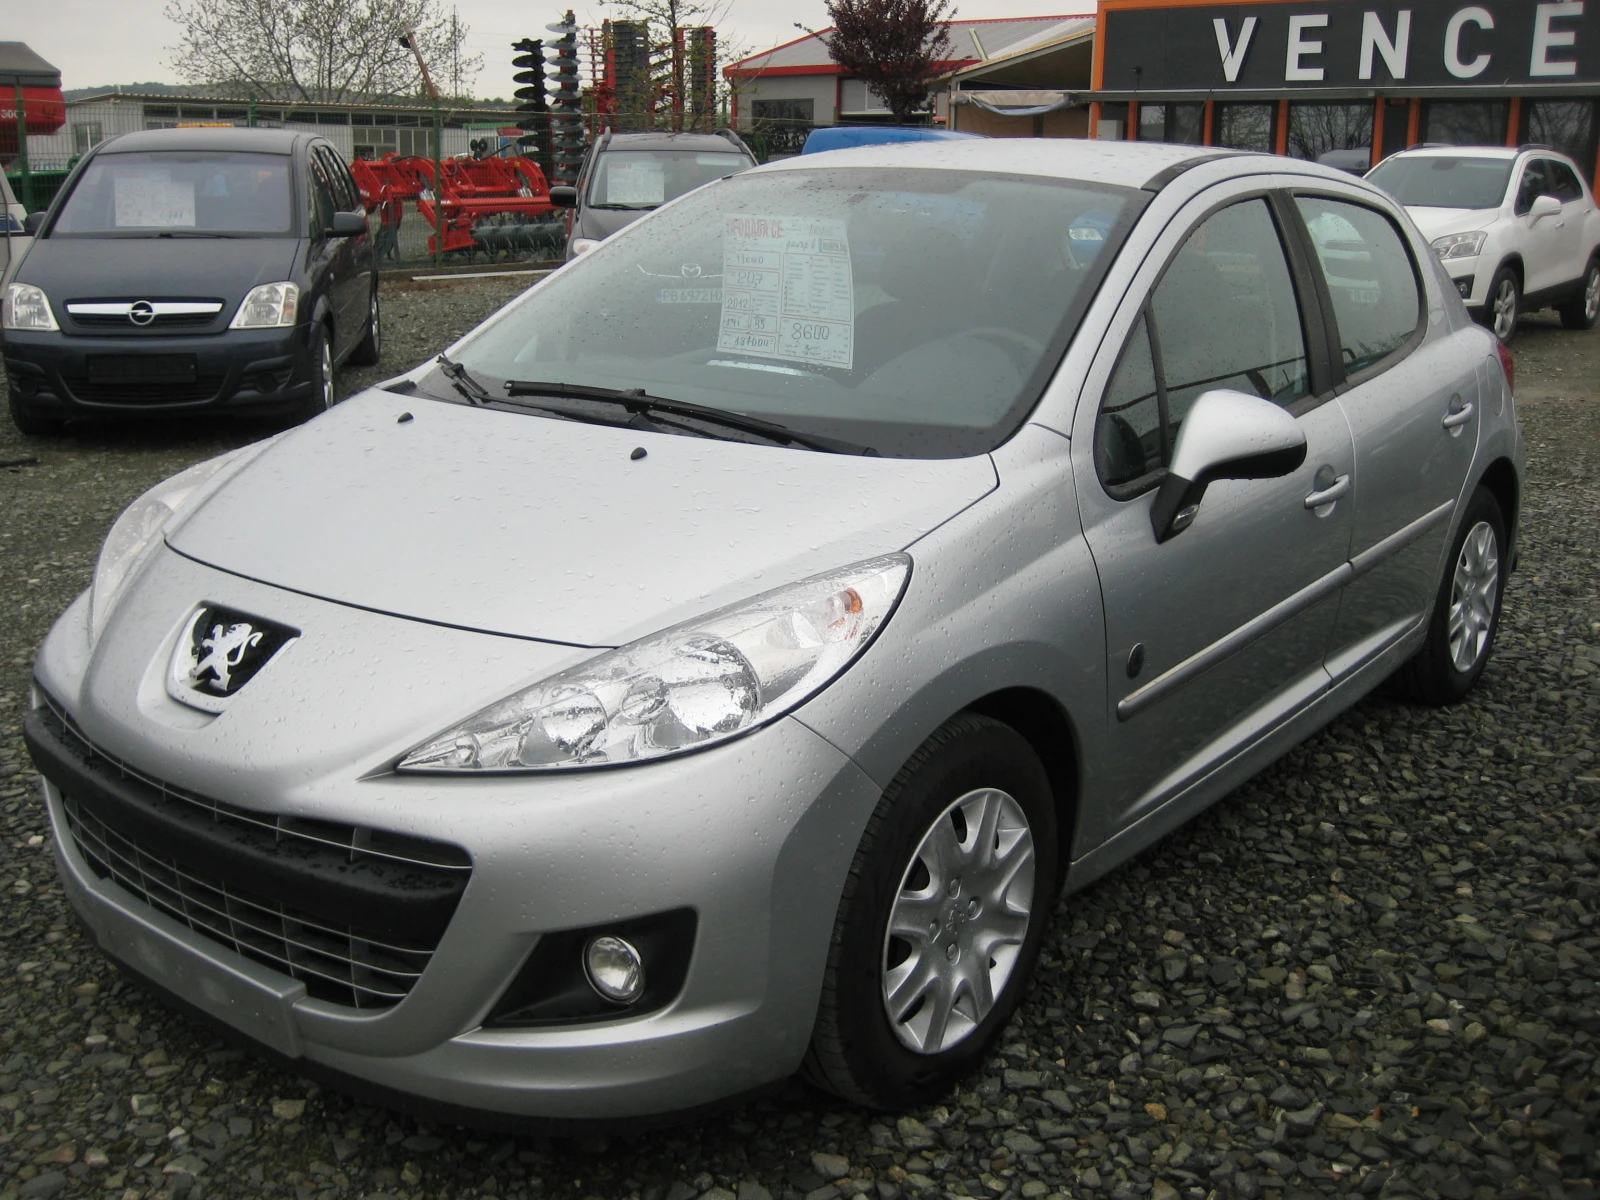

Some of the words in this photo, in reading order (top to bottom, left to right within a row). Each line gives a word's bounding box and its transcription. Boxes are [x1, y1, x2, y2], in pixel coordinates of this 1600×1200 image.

[1213, 2, 1584, 82] VENCE
[736, 271, 764, 284] 207
[727, 297, 748, 309] 2012
[791, 322, 830, 340] 8600
